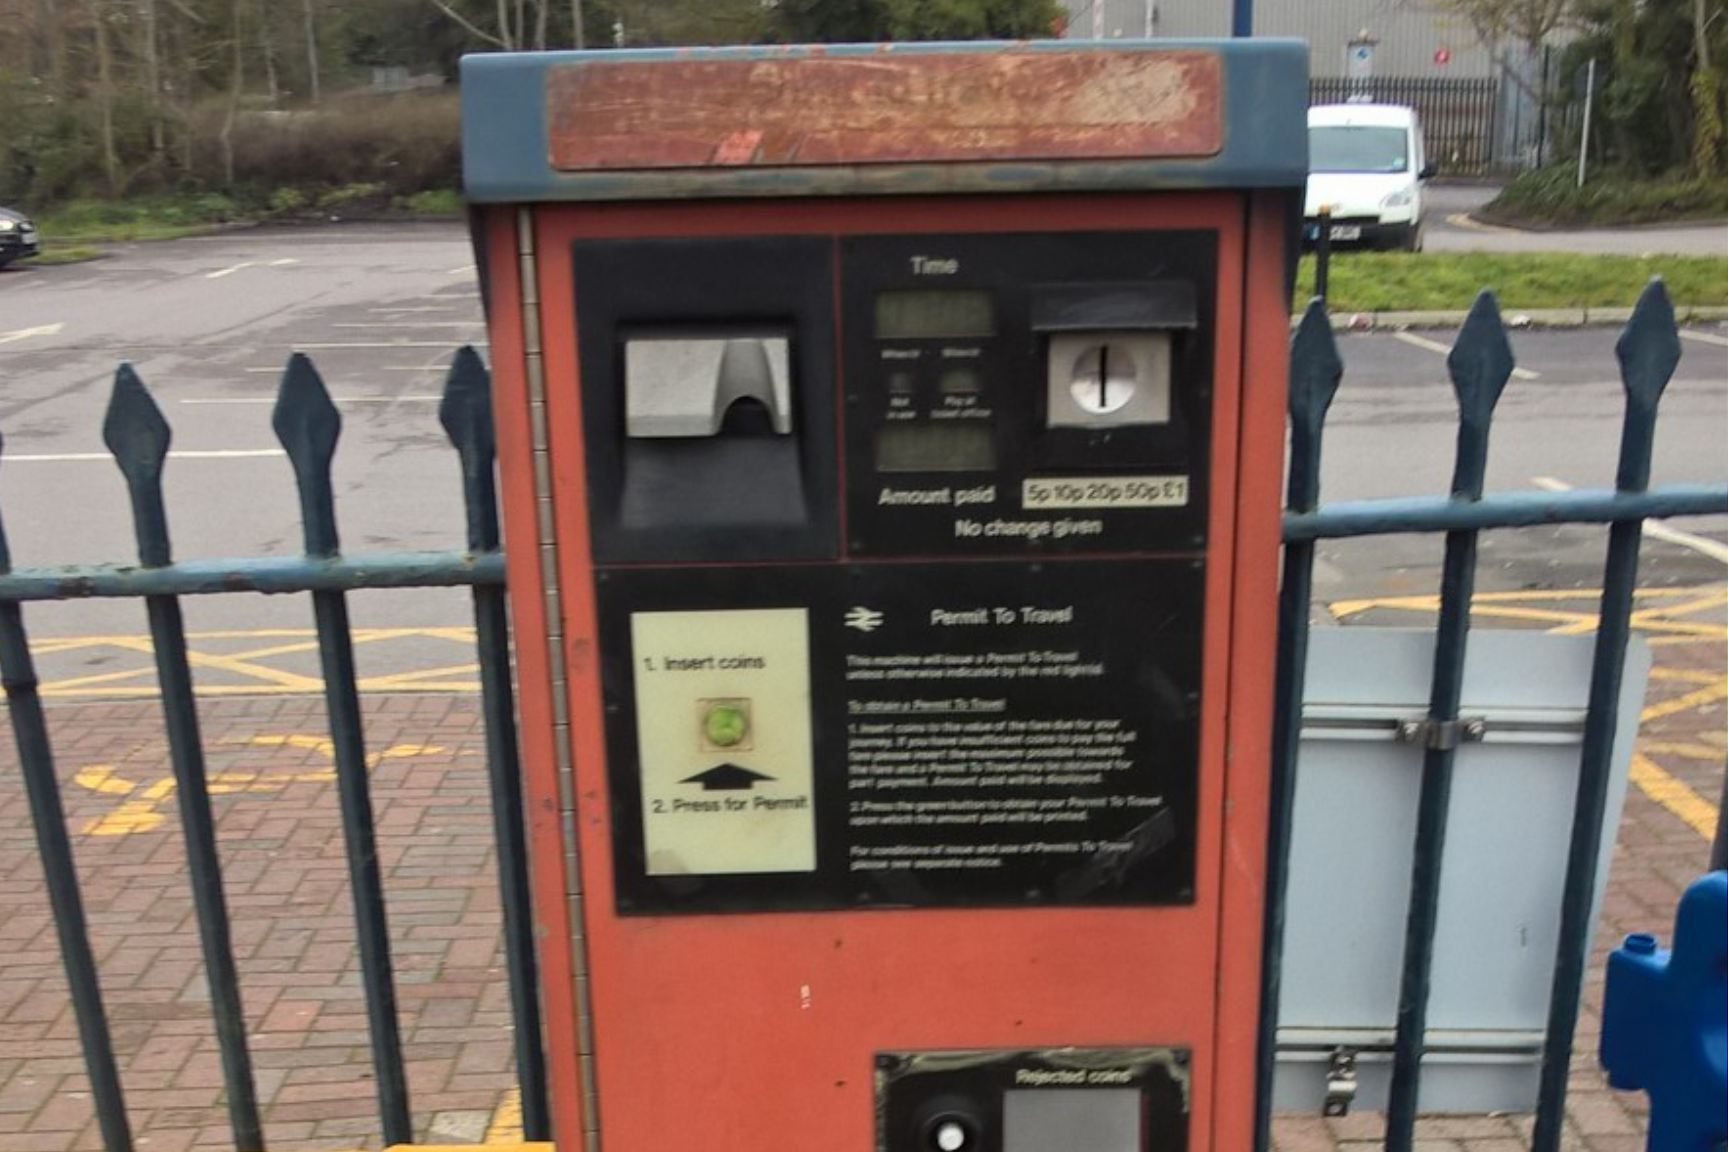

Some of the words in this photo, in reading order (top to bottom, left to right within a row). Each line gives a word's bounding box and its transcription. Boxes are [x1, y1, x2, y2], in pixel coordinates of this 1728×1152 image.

[910, 256, 958, 276] Time
[878, 487, 951, 505] Amount
[954, 485, 996, 507] paid
[1027, 484, 1049, 501] 5p
[1054, 484, 1083, 502] 10p
[1087, 482, 1122, 501] 20p
[1126, 481, 1158, 500] 50p
[1163, 480, 1184, 496] £1
[954, 520, 981, 537] No
[984, 519, 1049, 540] change
[1053, 518, 1102, 538] given
[931, 608, 989, 626] Permit
[993, 607, 1016, 624] To
[1020, 605, 1074, 624] Travel
[664, 656, 715, 670] Insert
[718, 655, 766, 670] coins
[652, 799, 666, 814] 2.
[671, 797, 721, 812] Press
[725, 796, 748, 810] for
[753, 795, 808, 810] Permit
[1015, 1069, 1086, 1085] Rejected
[1088, 1068, 1132, 1083] coins
